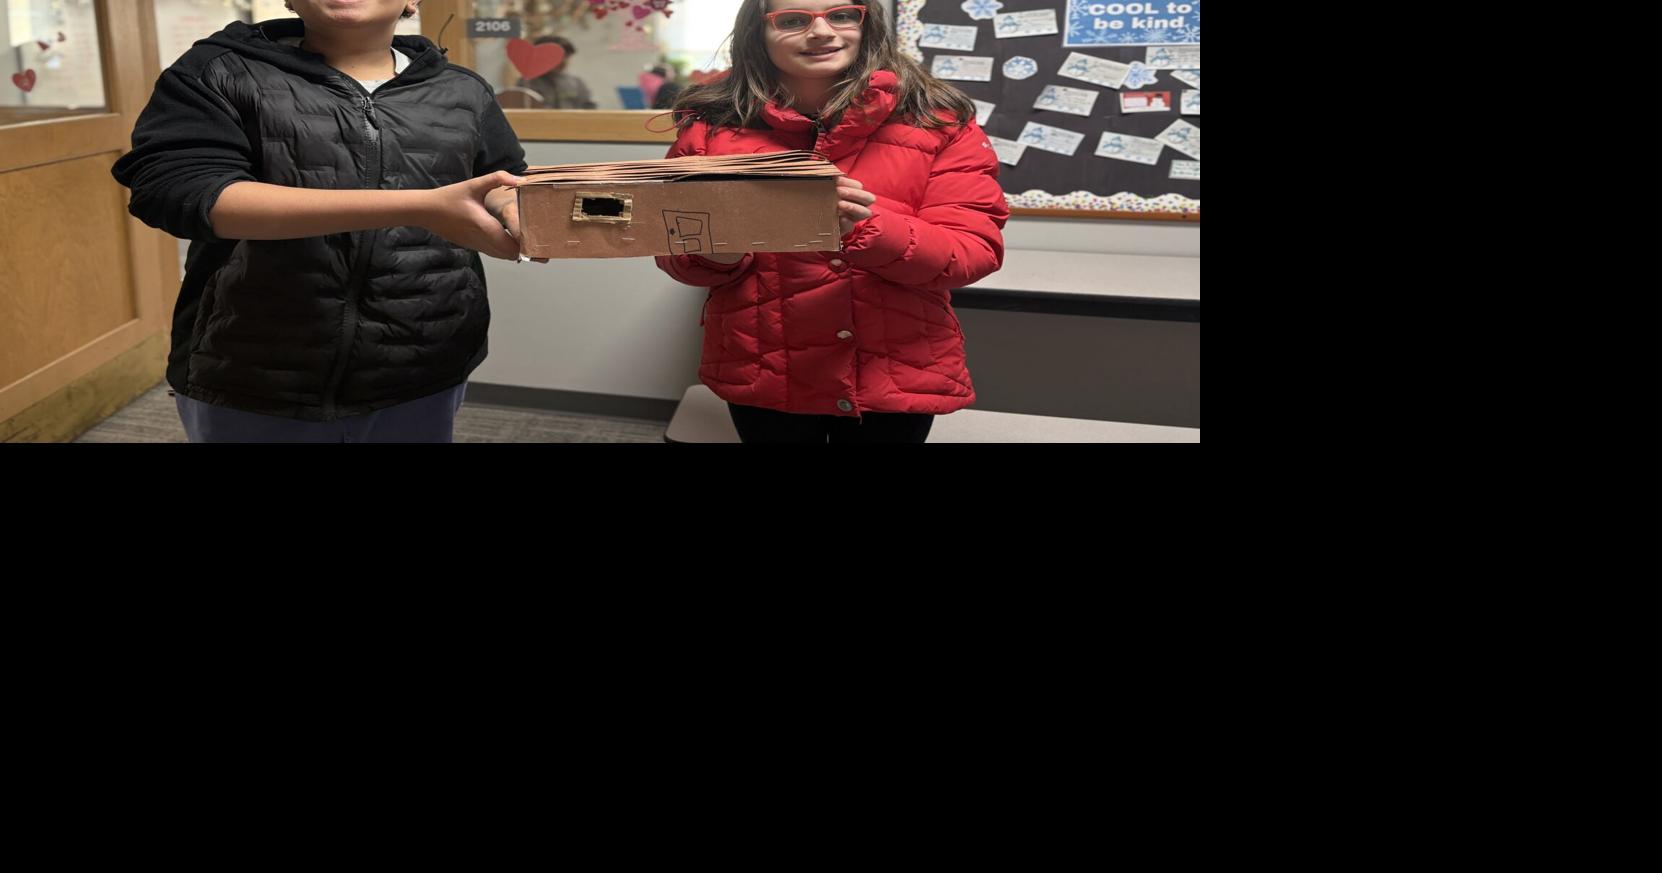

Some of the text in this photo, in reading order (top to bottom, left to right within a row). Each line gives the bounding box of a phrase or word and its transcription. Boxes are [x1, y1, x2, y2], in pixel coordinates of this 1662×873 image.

[1088, 2, 1193, 16] COOL to
[475, 20, 511, 32] 2106
[1093, 15, 1185, 30] be kind
